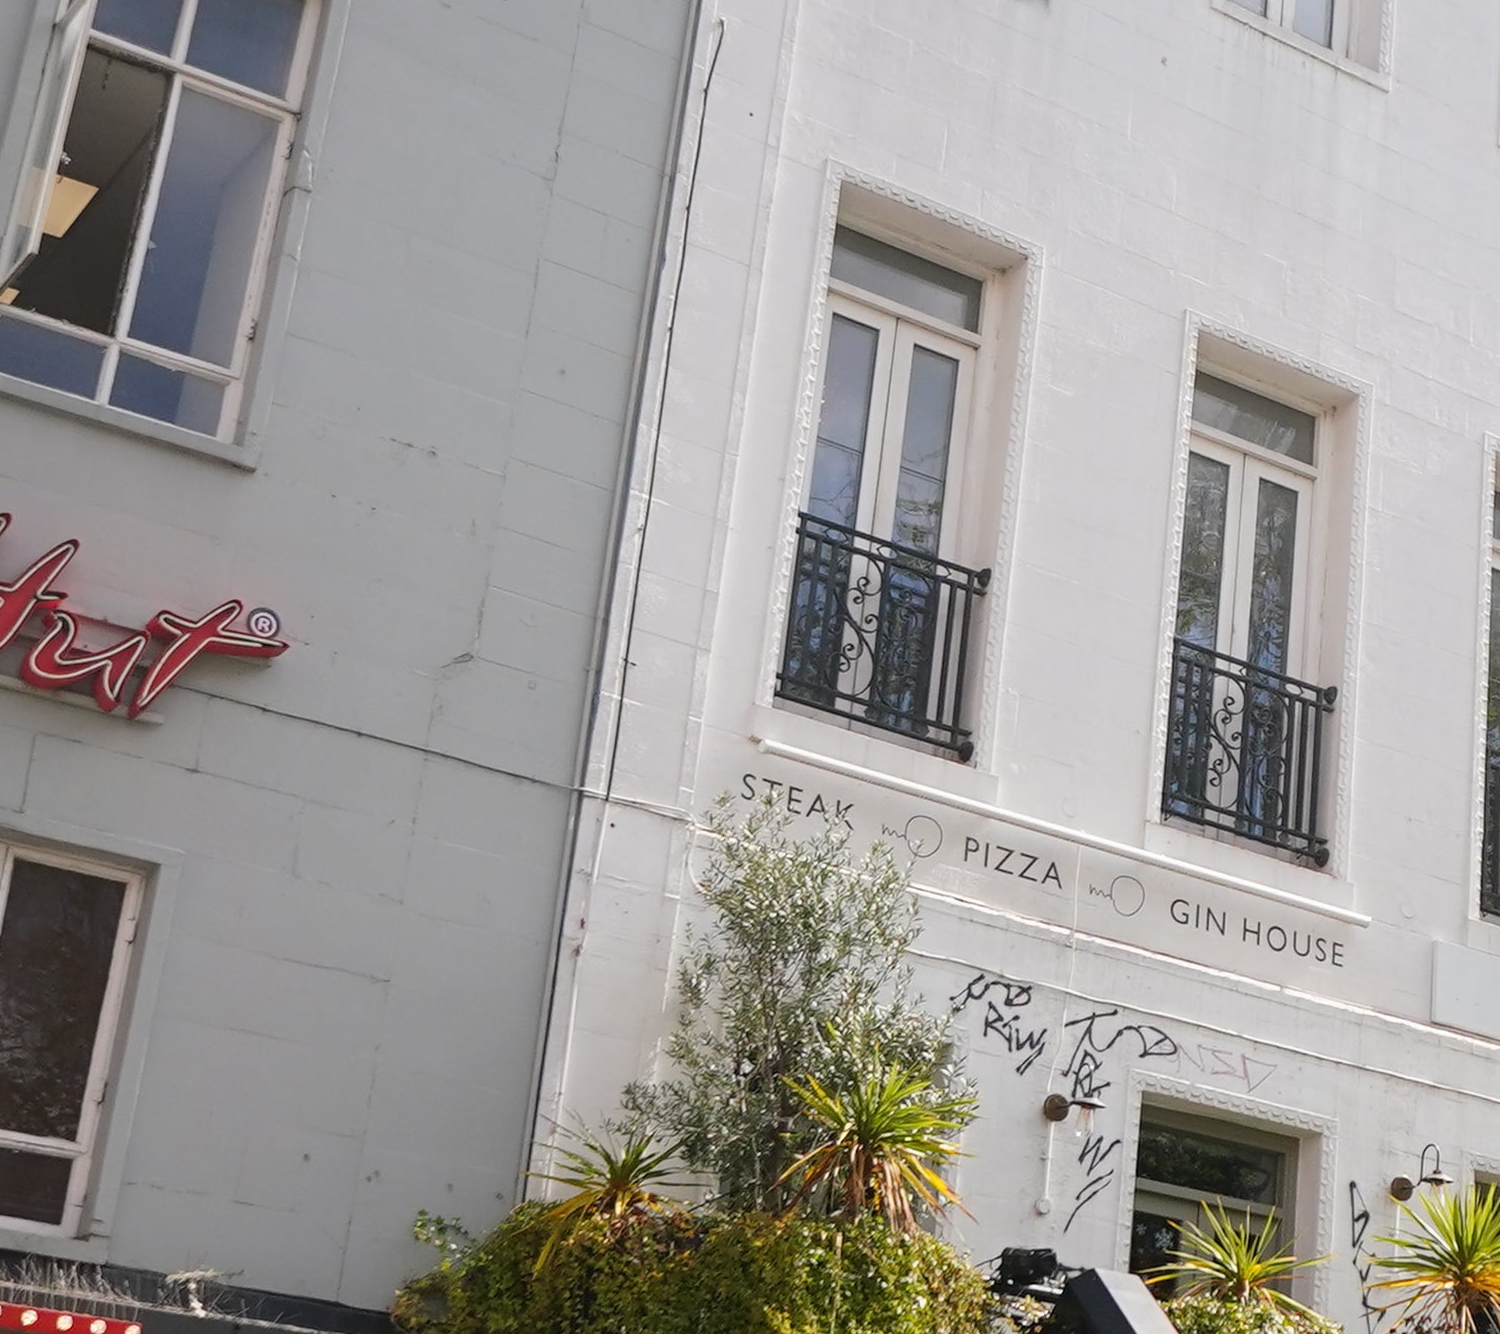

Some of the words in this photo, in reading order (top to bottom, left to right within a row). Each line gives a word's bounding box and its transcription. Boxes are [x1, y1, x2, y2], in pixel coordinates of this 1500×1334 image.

[741, 773, 856, 831] STEAK
[964, 836, 1063, 890] PIZZA
[1170, 899, 1227, 936] GIN
[1242, 917, 1345, 967] HOUSE
